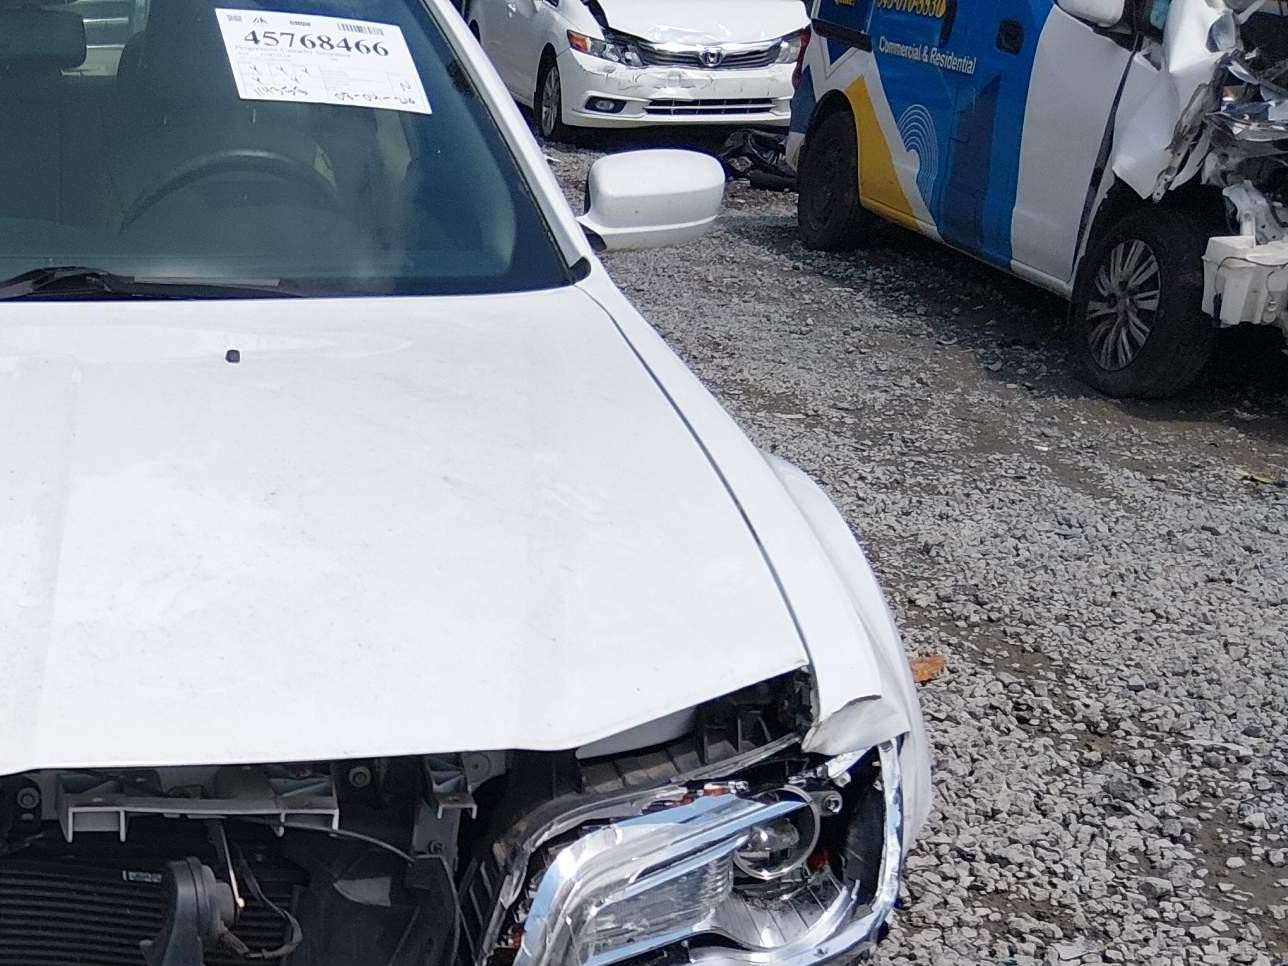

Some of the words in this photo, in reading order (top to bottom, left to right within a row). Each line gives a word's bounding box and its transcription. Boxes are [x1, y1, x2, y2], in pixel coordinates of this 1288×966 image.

[244, 29, 390, 57] 45768466
[878, 35, 922, 61] Commercial
[922, 46, 929, 63] &
[929, 47, 977, 75] Residential
